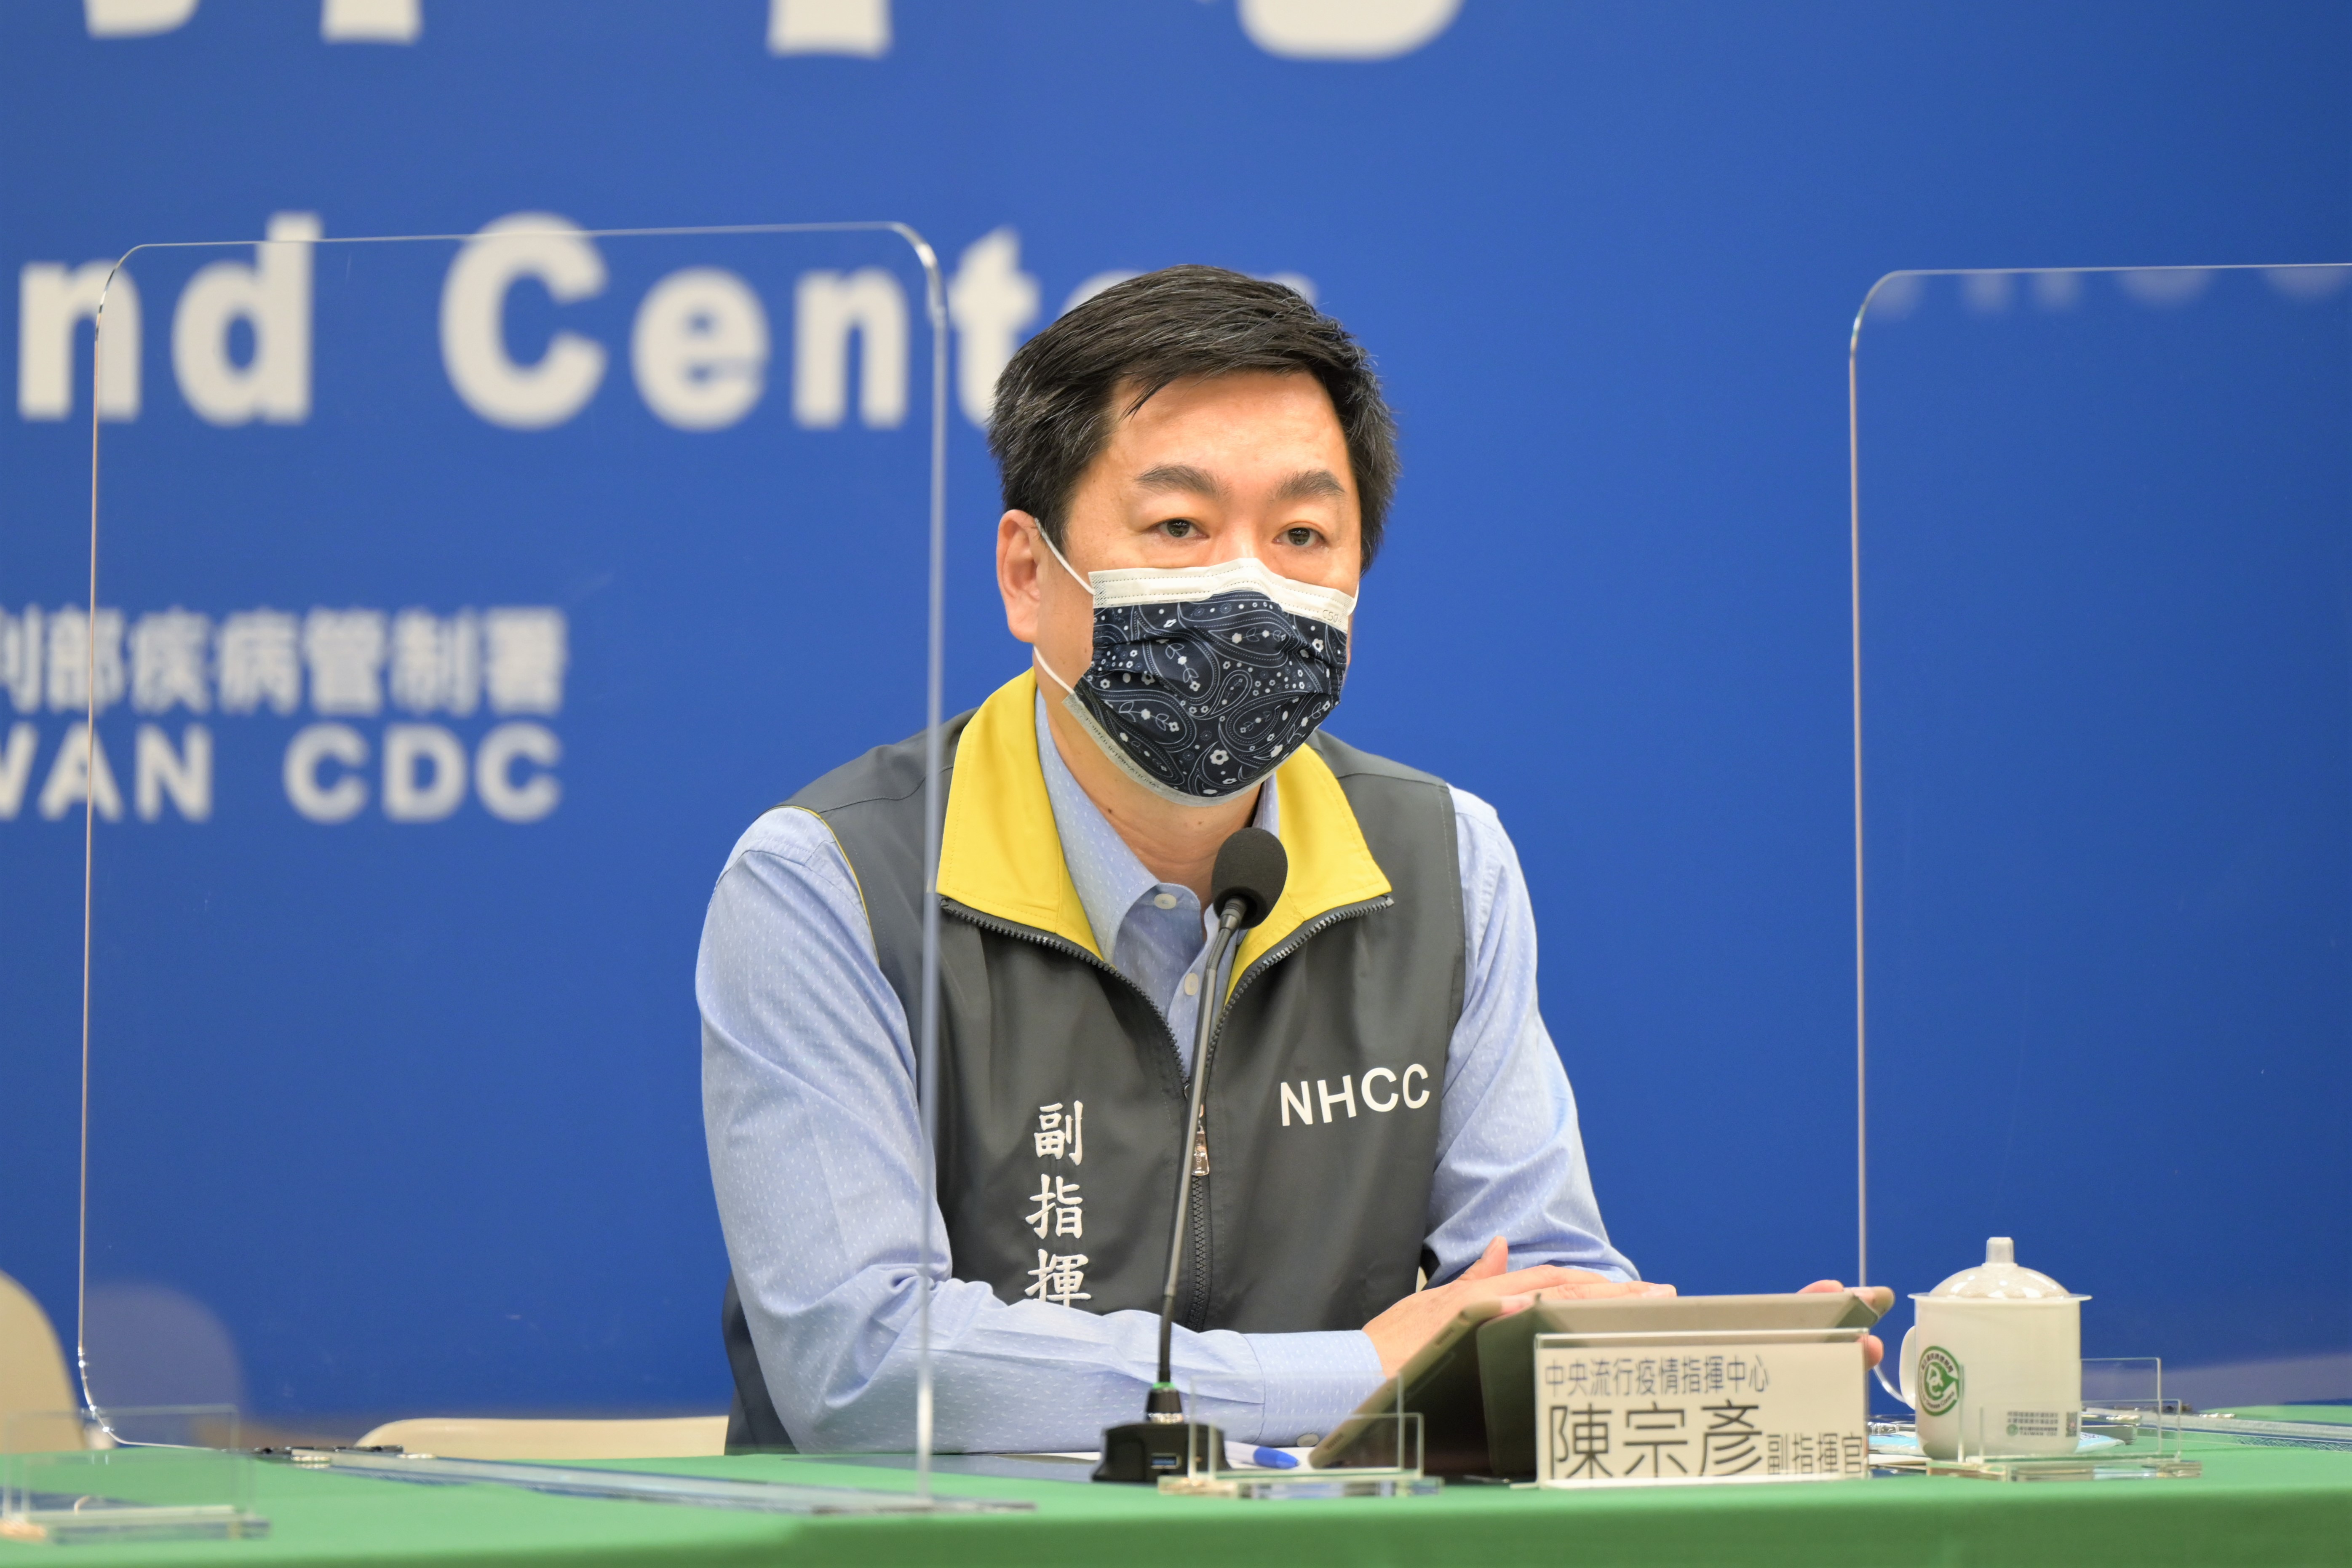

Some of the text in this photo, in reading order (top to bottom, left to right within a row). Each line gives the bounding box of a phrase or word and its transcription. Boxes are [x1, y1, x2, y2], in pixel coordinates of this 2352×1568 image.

[283, 721, 563, 824] CDC
[1280, 1063, 1430, 1127] NHCC
[1024, 1100, 1092, 1307] 副指揮
[1545, 1355, 1769, 1397] 中央流行疫情指揮中心
[1549, 1398, 1863, 1480] 陳宗彥 副指揮官
